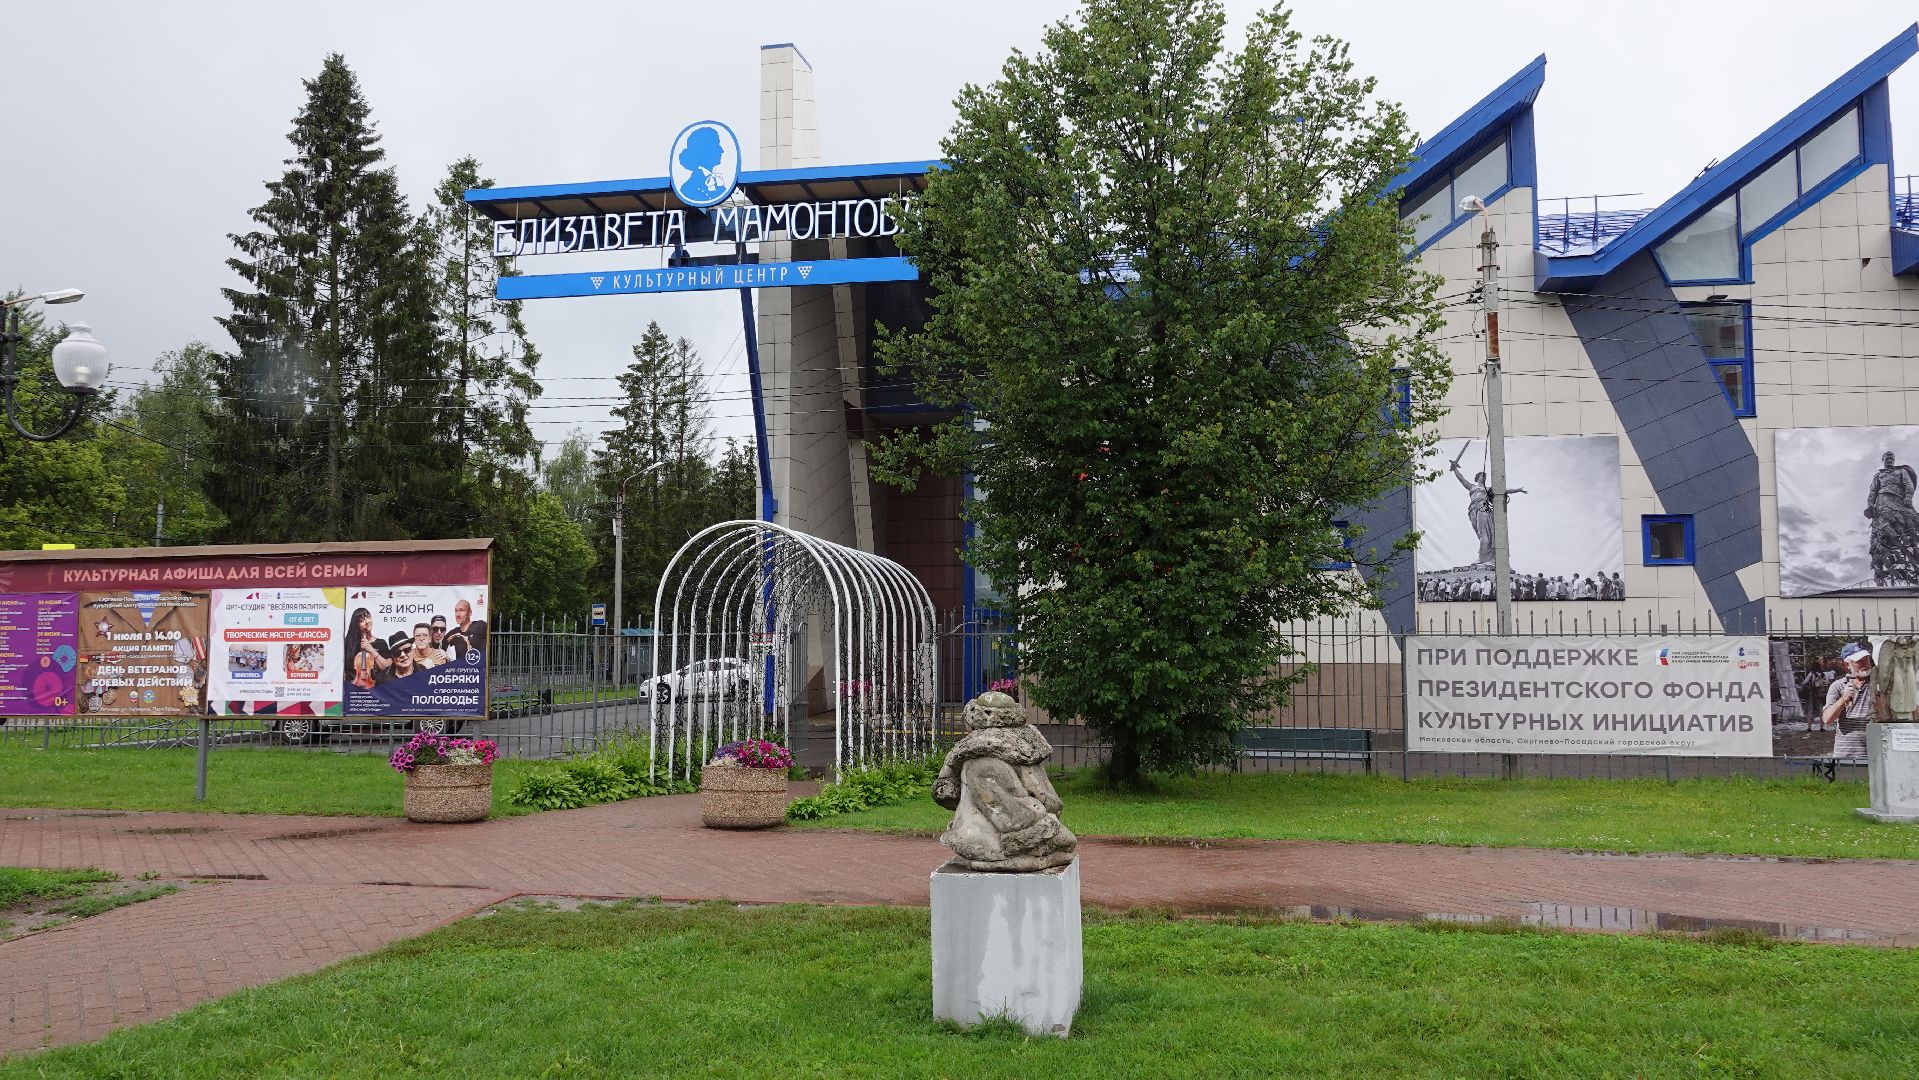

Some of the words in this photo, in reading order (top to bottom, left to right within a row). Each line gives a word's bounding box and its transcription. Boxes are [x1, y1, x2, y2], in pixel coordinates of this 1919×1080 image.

[494, 209, 687, 257] ЕЛИЗАВЕТА
[613, 268, 723, 289] КУЛЬТУРНЫЙ
[734, 266, 788, 285] ЦЕНТР
[64, 568, 159, 583] КУЛЬТУРНАЯ
[163, 566, 225, 581] АФИША
[226, 566, 260, 580] ДЛЯ
[264, 562, 307, 579] ВСЕЙ
[311, 564, 369, 578] СЕМЬИ
[379, 604, 392, 614] 28
[396, 604, 434, 614] ИЮНЯ
[114, 632, 142, 641] июля
[154, 630, 181, 641] 14.00
[226, 631, 268, 639] ТВОРЧЕСКИЕ
[269, 631, 329, 639] МАСТЕР-КЛАССЫ:
[112, 645, 140, 653] АКЦИЯ
[141, 644, 174, 652] ПАМЯТИ
[467, 653, 479, 661] 12+
[1418, 648, 1467, 666] ПРИ
[1476, 648, 1639, 670] ПОДДЕРЖКЕ
[97, 665, 126, 675] ДЕНЬ
[127, 665, 187, 674] ВЕТЕРАНОВ
[91, 678, 135, 687] БОЕВЫХ
[136, 676, 193, 687] ДЕЙСТВИЙ
[428, 674, 480, 685] ДОБРЯКИ
[1418, 680, 1653, 701] ПРЕЗИДЕНТСКОГО
[1662, 681, 1765, 703] ФОНДА
[55, 696, 68, 707] 0+
[412, 695, 479, 705] ПОЛОВОДЬЕ
[1418, 711, 1584, 731] КУЛЬТУРНЫХ
[1593, 713, 1754, 735] ИНИЦИАТИВ
